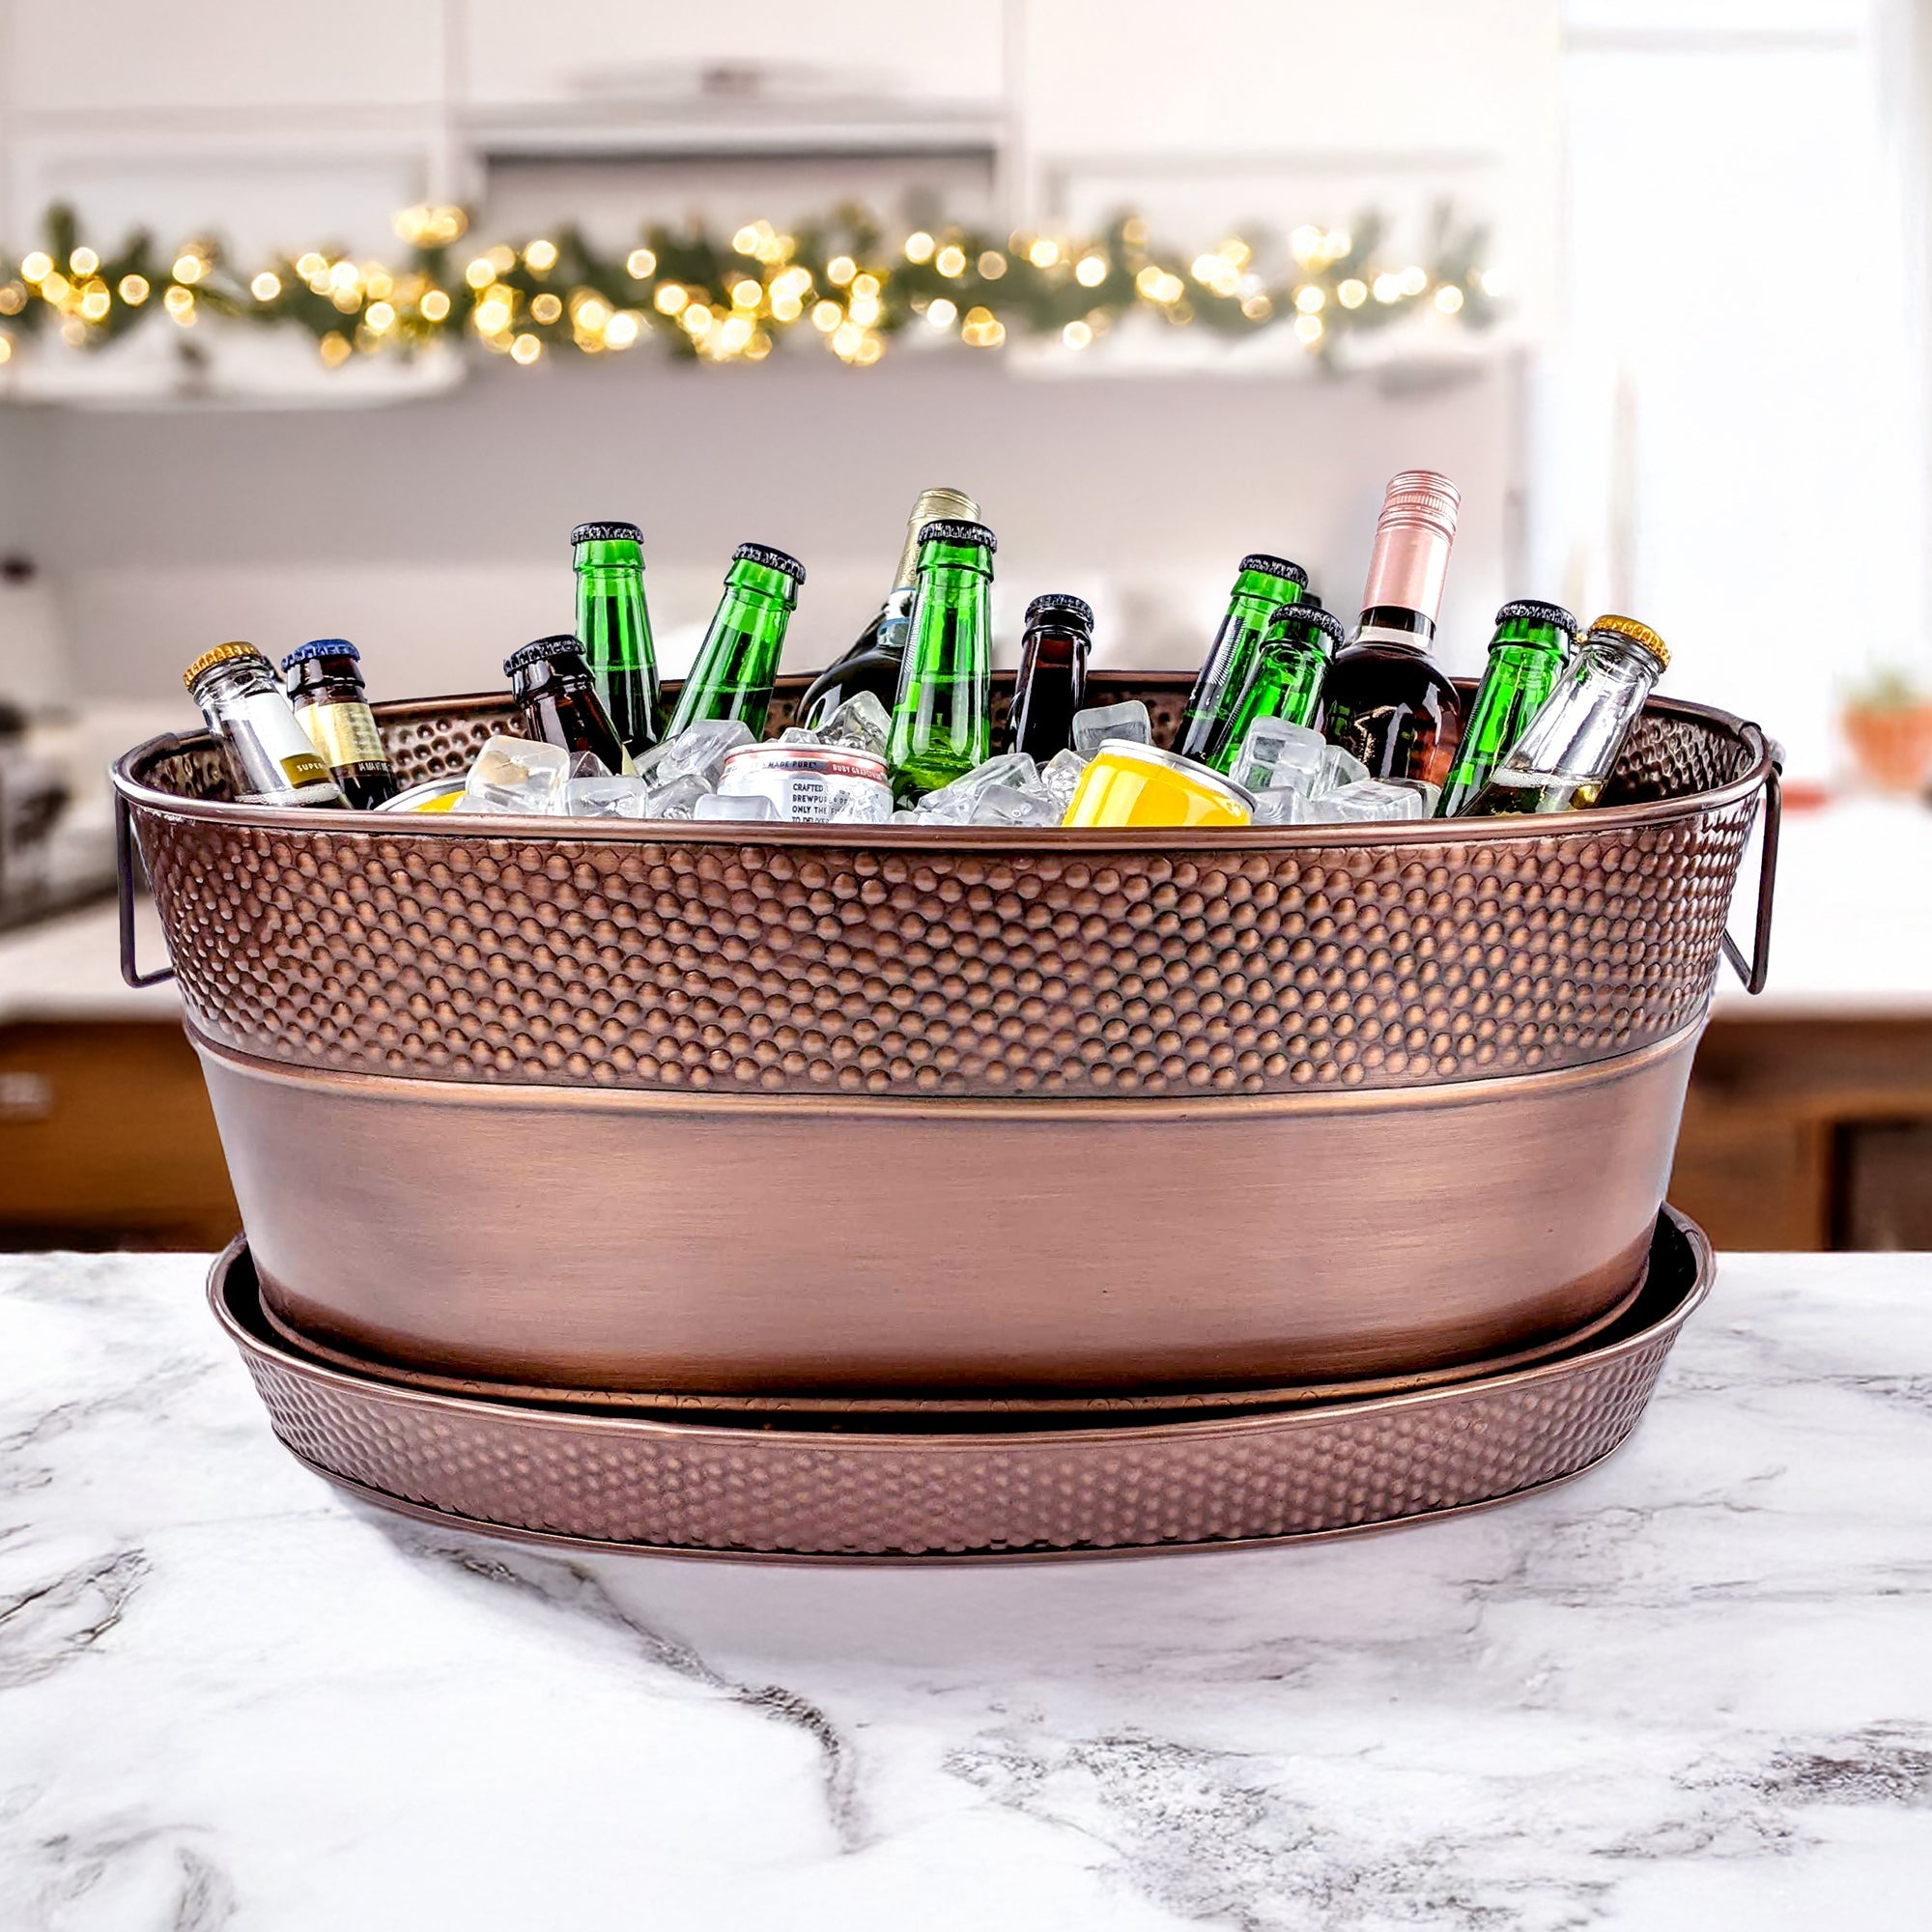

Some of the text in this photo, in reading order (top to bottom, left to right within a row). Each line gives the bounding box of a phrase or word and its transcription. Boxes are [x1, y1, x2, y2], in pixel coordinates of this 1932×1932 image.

[833, 764, 850, 773] RUBY
[792, 783, 824, 792] CRAFTED
[792, 805, 811, 813] ONLY
